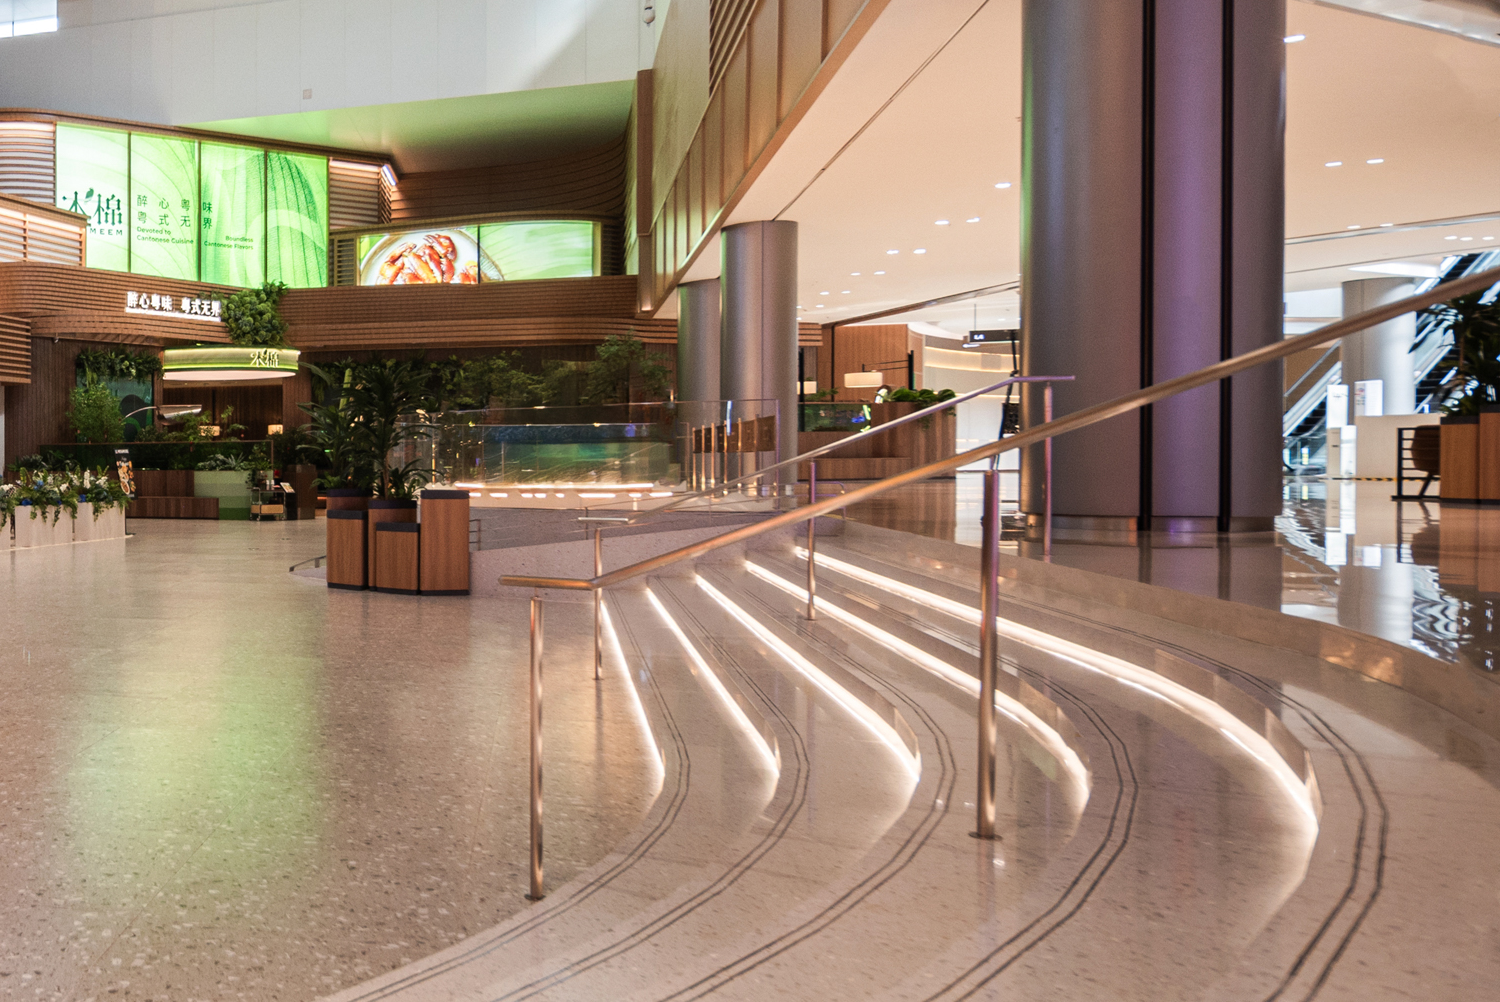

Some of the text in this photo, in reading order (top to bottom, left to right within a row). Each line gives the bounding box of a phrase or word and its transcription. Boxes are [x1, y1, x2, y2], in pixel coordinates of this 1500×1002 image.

[137, 211, 212, 229] 粤式无界
[137, 226, 163, 234] Devoted
[137, 234, 194, 245] Cantonese Cuisine
[225, 235, 254, 243] Boundless
[203, 240, 254, 250] Cantonese Flavors
